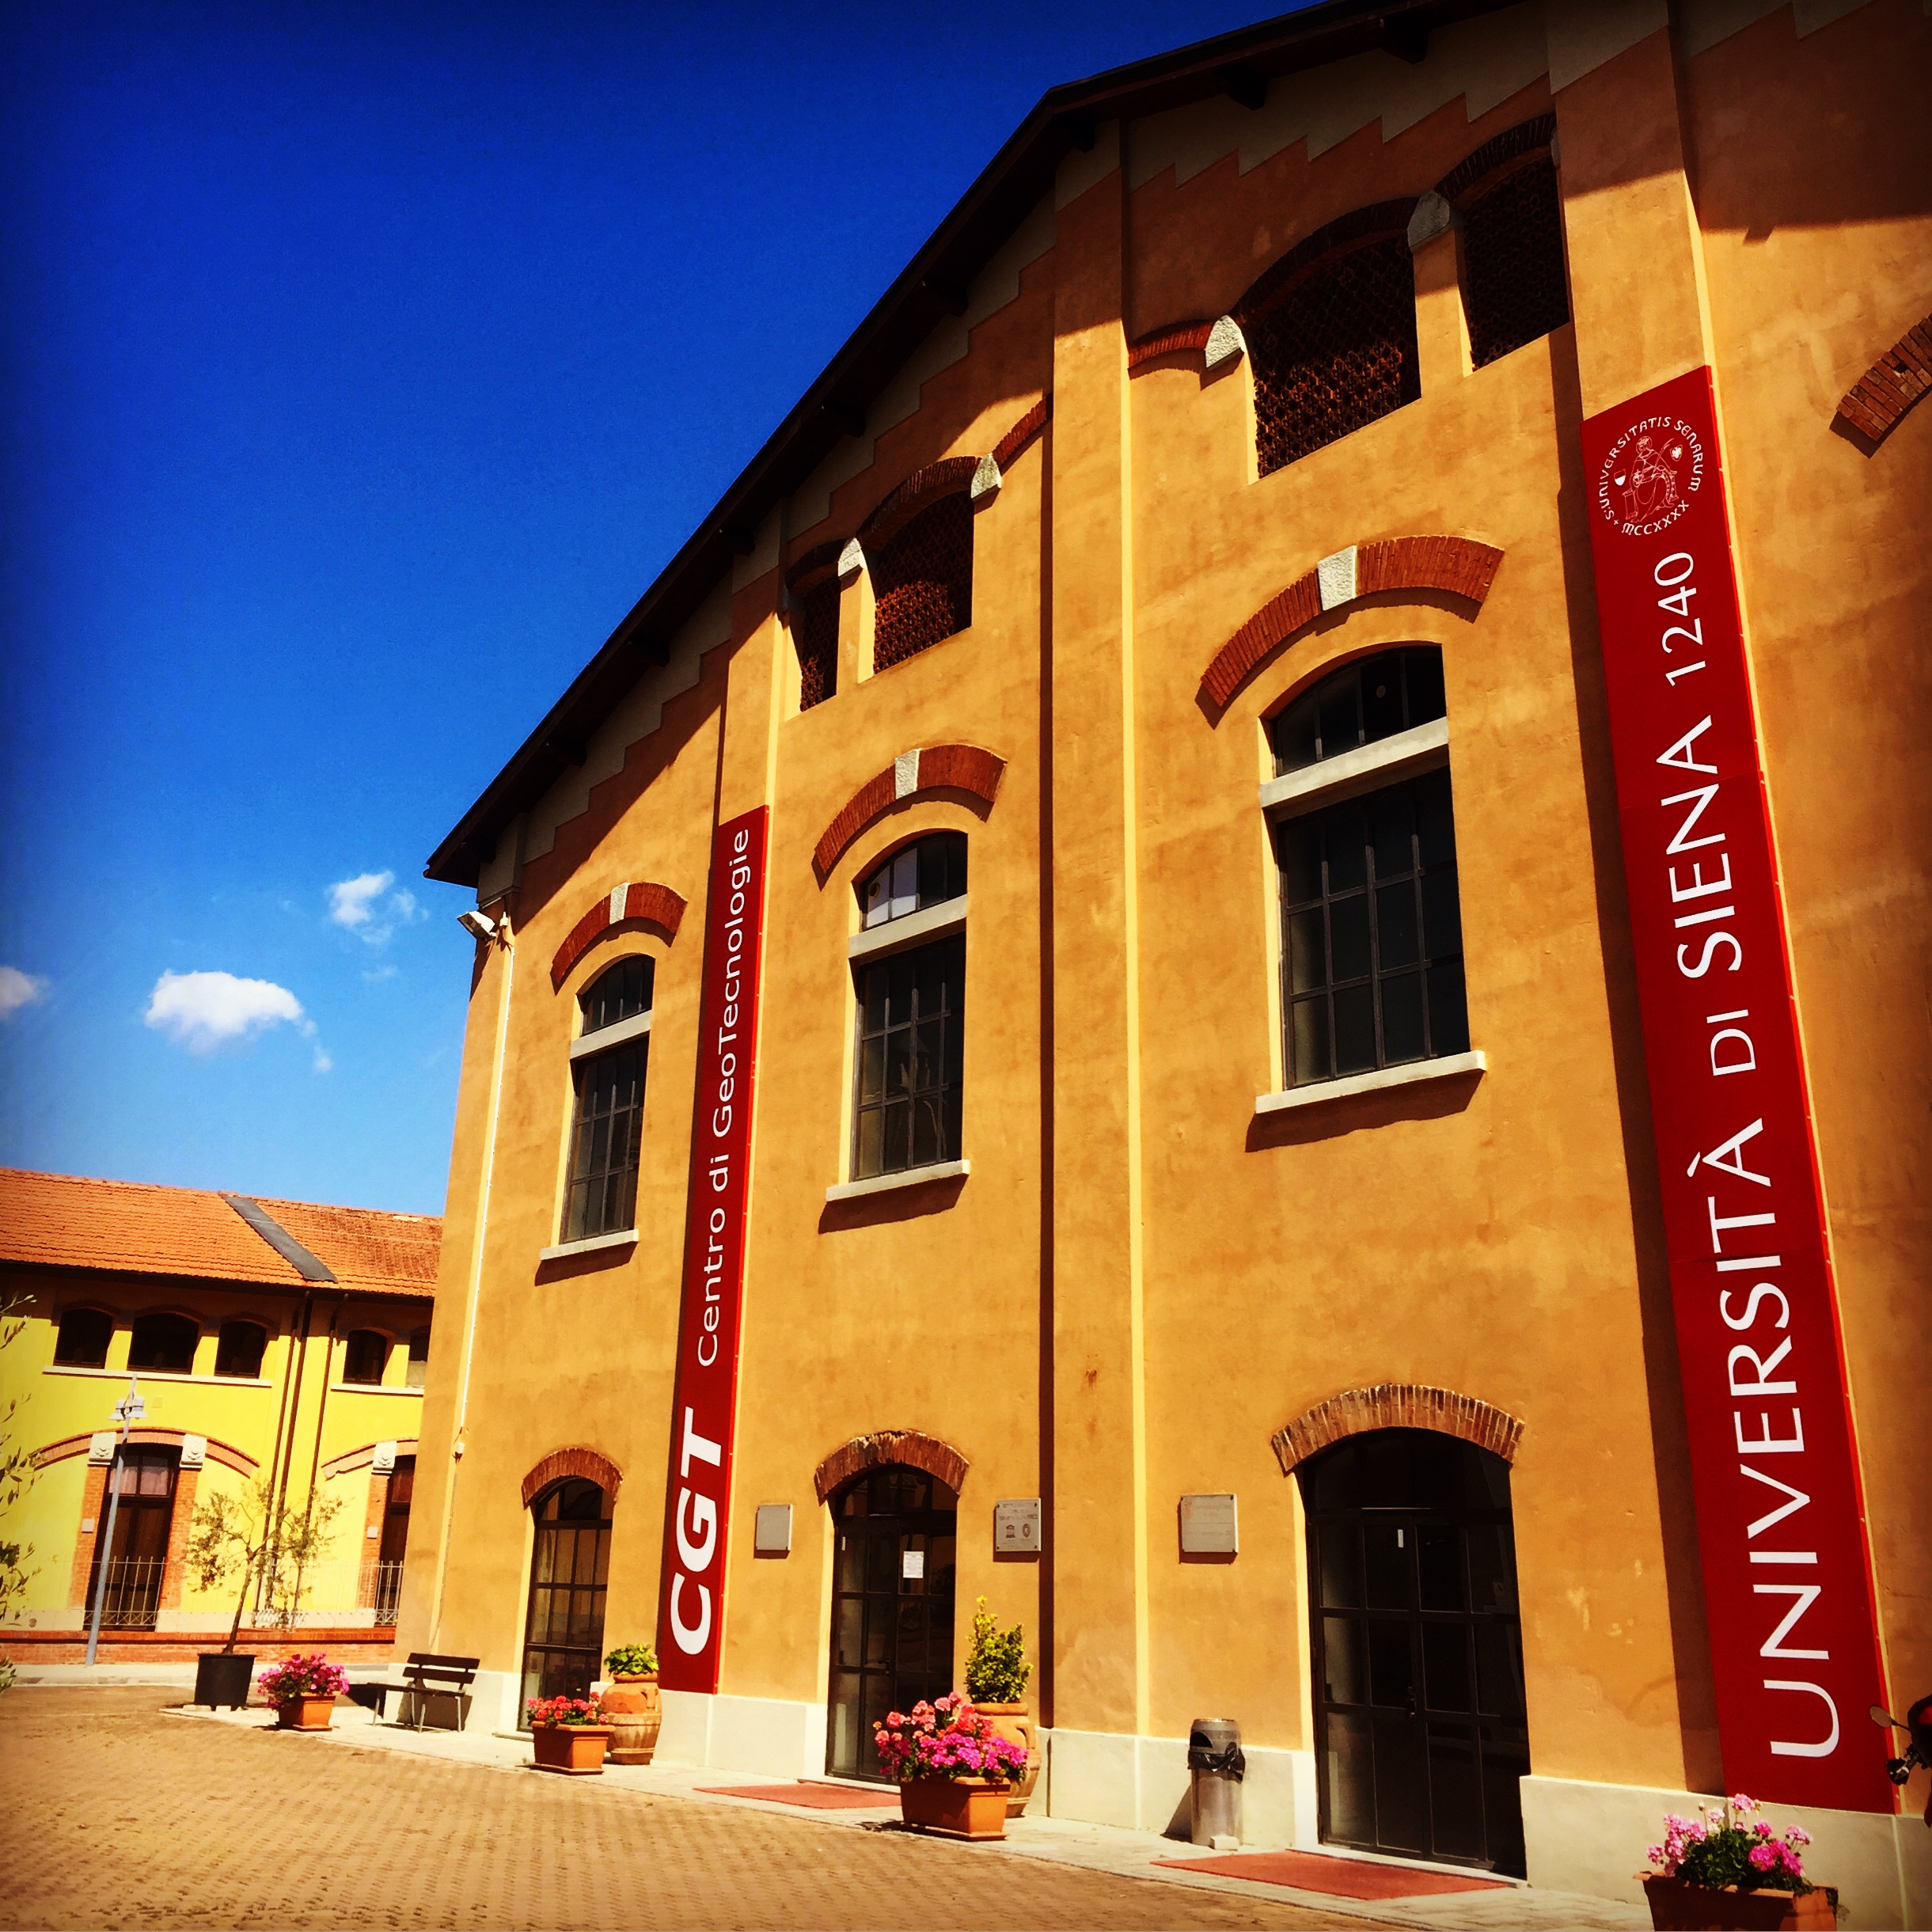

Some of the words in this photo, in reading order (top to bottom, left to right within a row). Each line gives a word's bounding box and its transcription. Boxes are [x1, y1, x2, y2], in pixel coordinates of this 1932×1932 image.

[1621, 499, 1690, 536] MCCXXXX
[1673, 419, 1703, 492] SENARUM
[1654, 552, 1706, 687] 1240
[1656, 715, 1742, 978] SIENA
[712, 829, 751, 1138] GeoTecnologie
[1706, 1009, 1756, 1076] DI
[708, 1154, 729, 1192] di
[697, 1208, 726, 1367] Centro
[1687, 1118, 1839, 1757] UNIVERSITÀ
[670, 1406, 722, 1655] CGT
